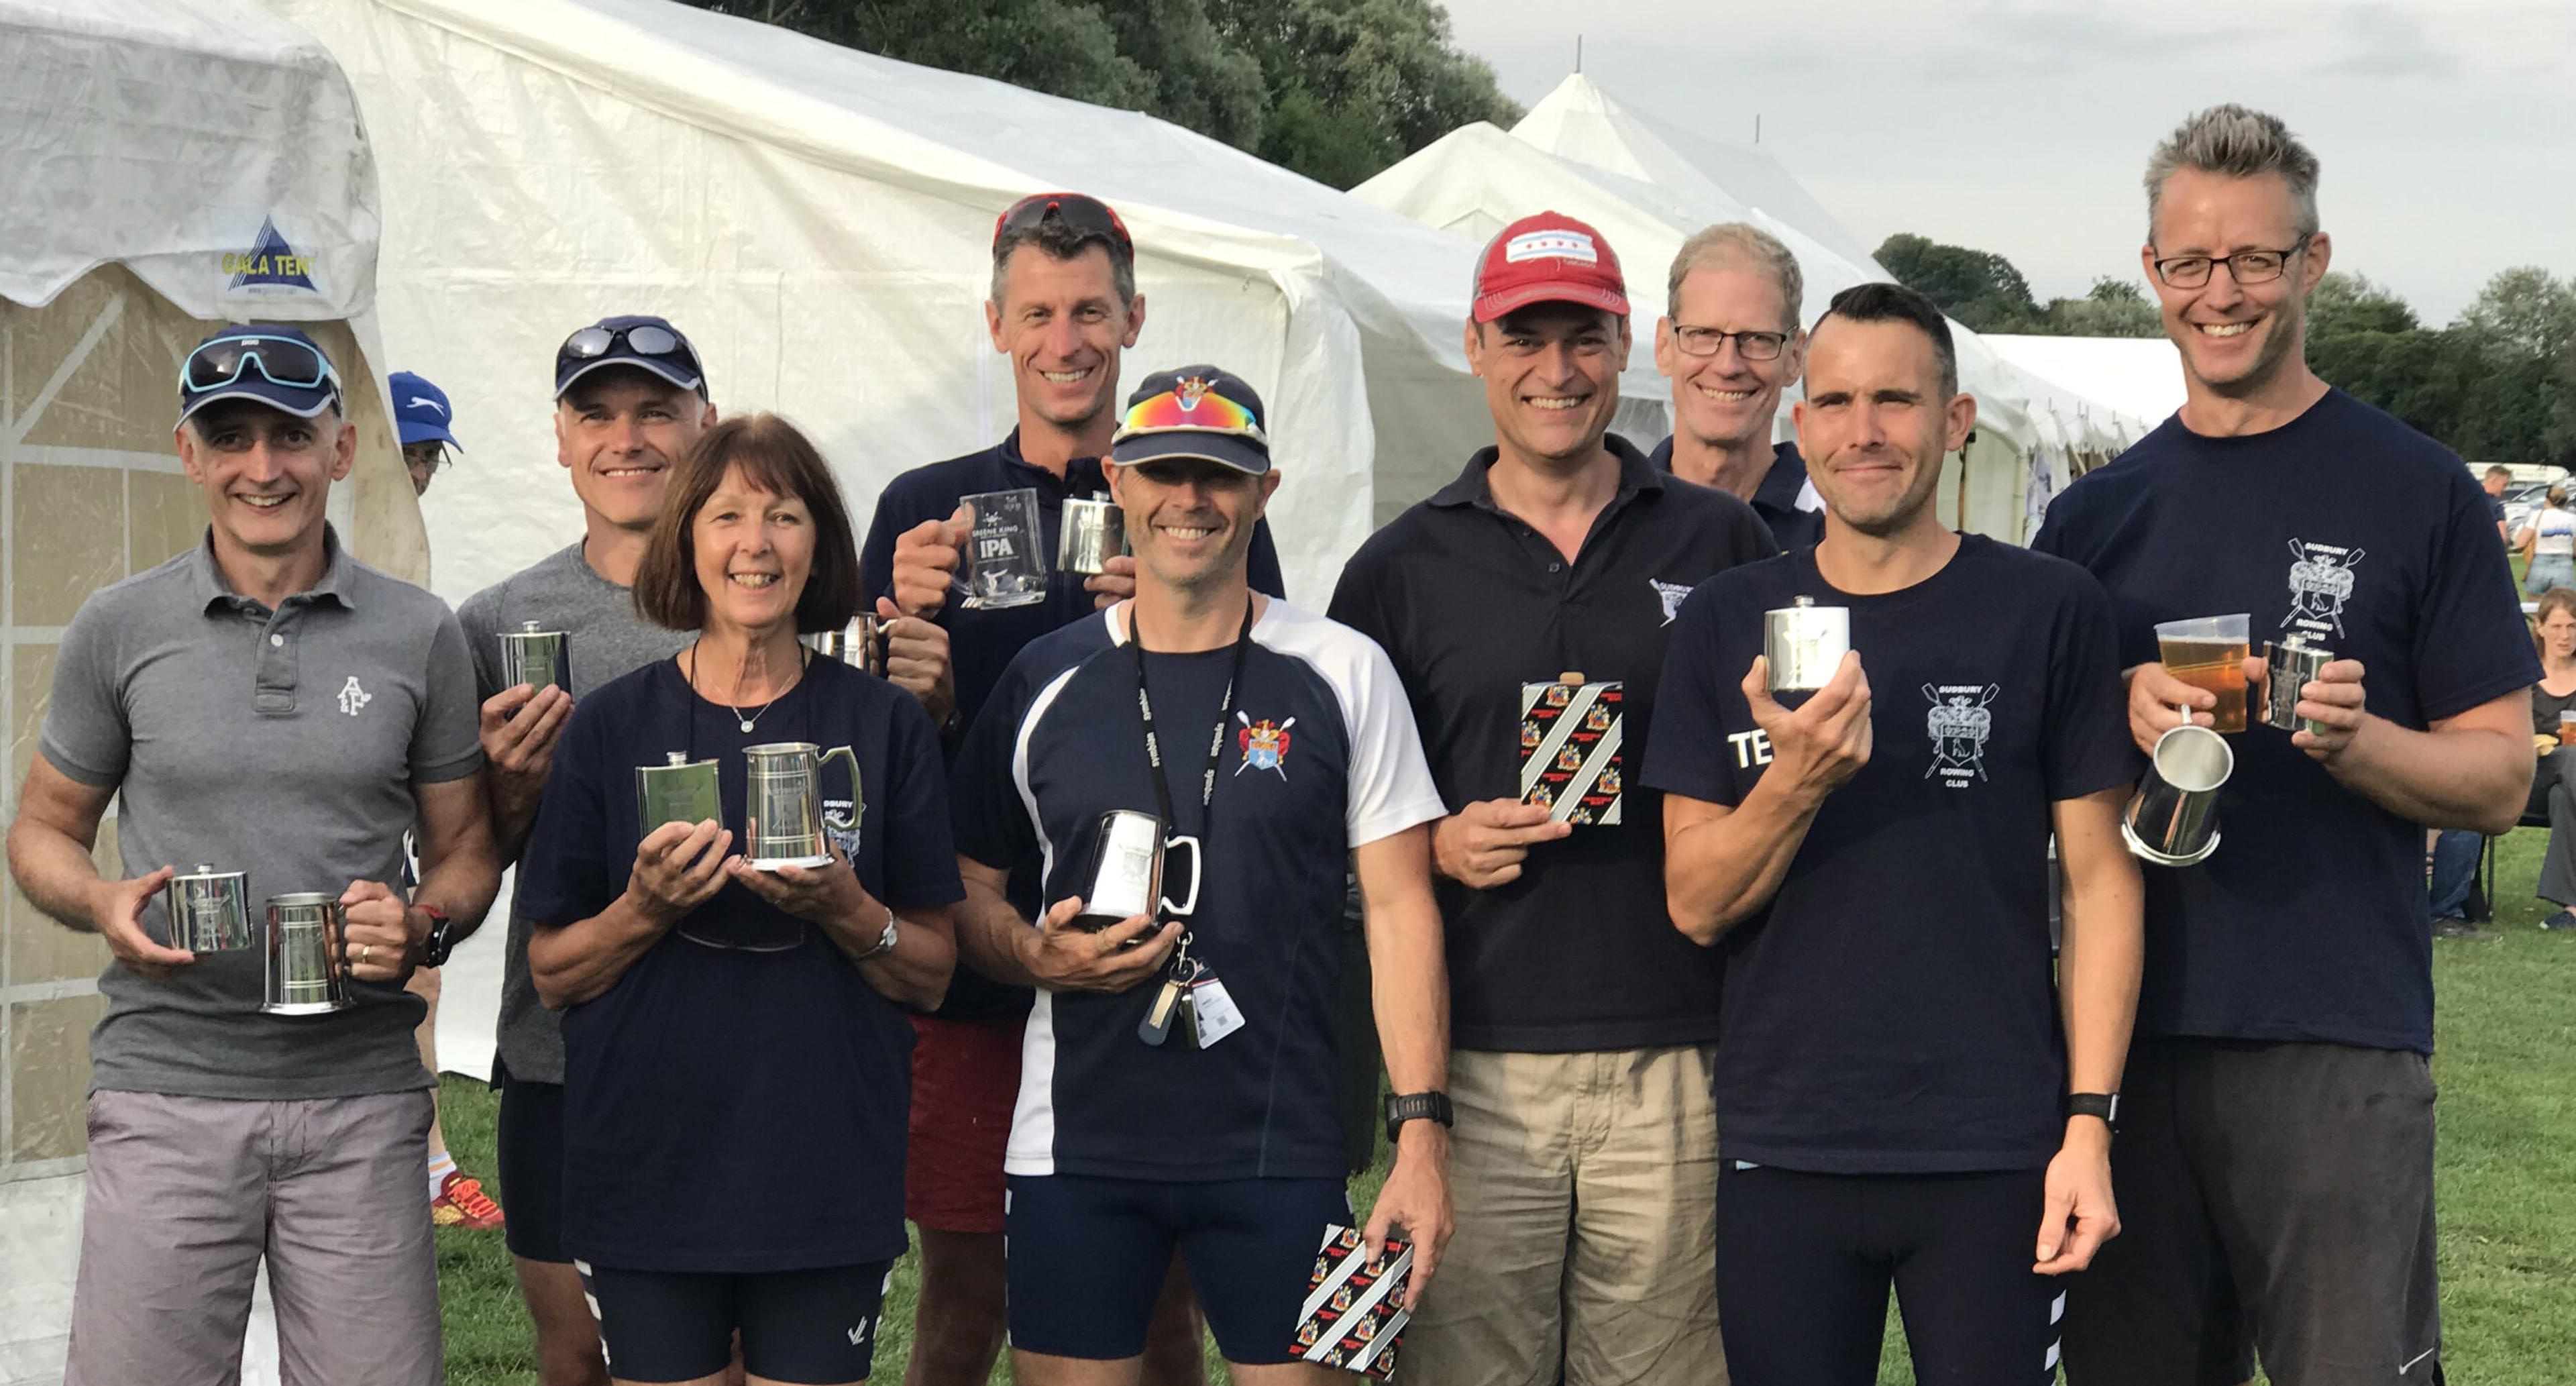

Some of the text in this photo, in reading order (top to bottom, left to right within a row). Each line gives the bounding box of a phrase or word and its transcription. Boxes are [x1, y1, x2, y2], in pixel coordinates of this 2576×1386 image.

[221, 252, 317, 276] GALA TENT
[980, 538, 1014, 559] IPA
[2304, 542, 2349, 555] SUDBURY
[2296, 618, 2334, 631] ROWING
[1939, 685, 1983, 694] SUDBURY
[1727, 728, 1773, 769] TE
[1939, 767, 1975, 778] ROWING
[1945, 779, 1969, 788] CLUB
[823, 799, 854, 808] DBURY
